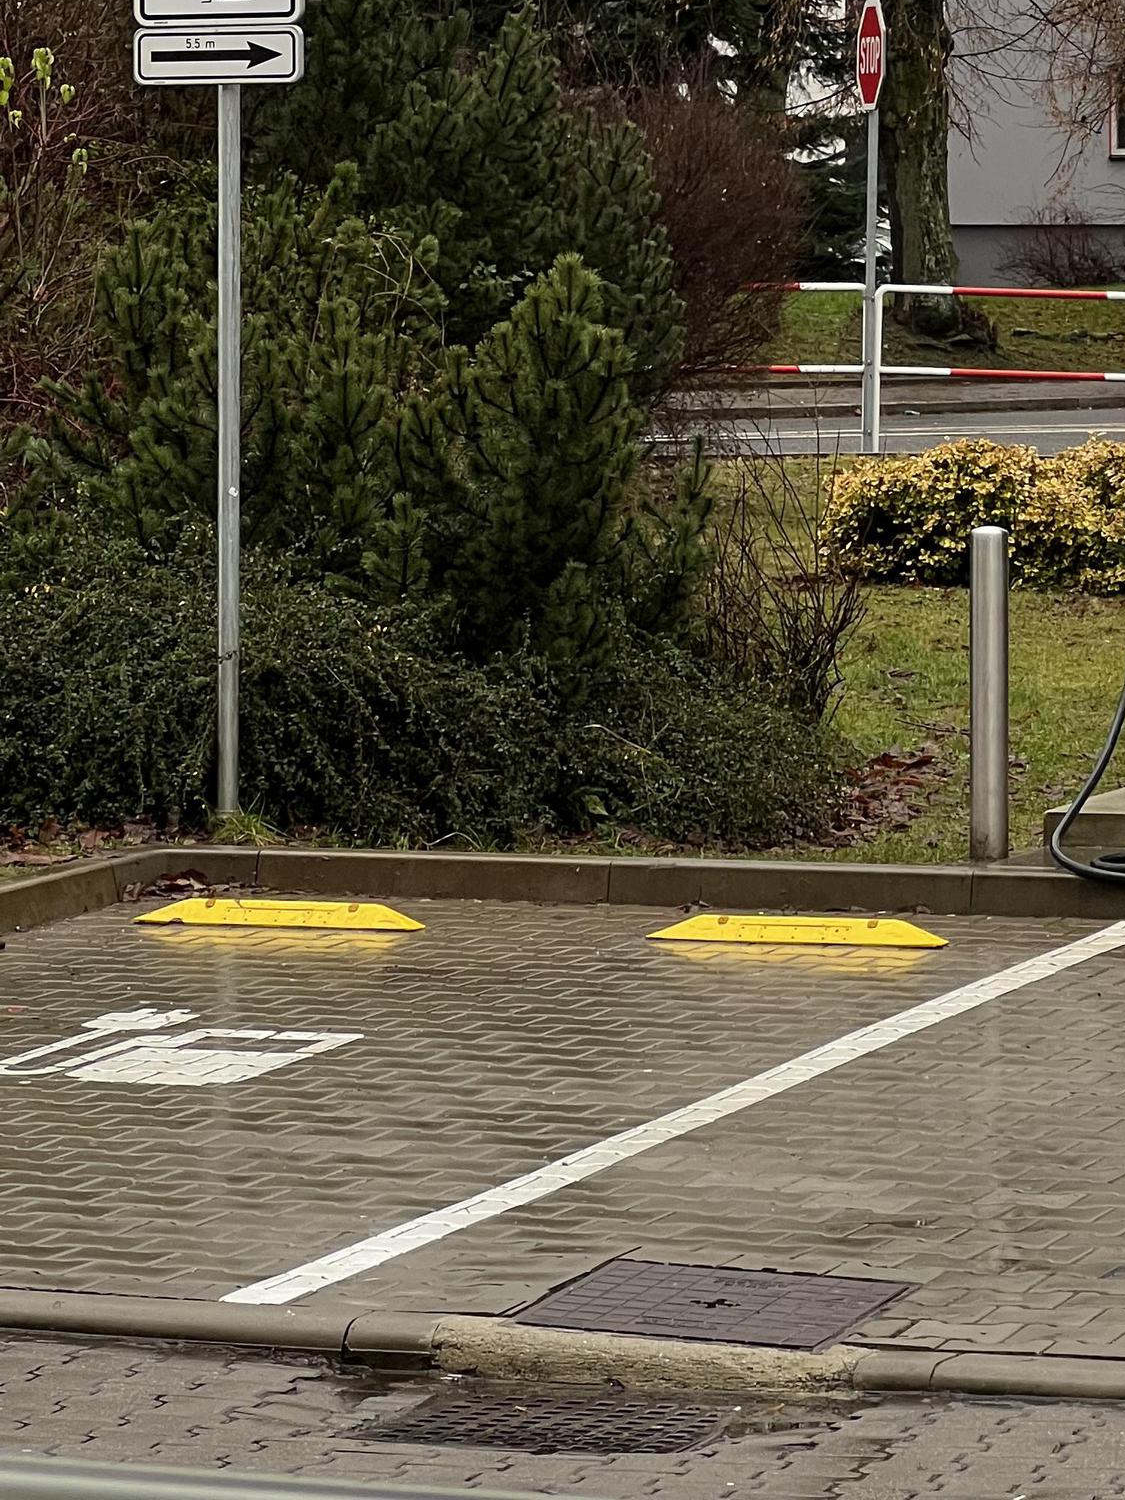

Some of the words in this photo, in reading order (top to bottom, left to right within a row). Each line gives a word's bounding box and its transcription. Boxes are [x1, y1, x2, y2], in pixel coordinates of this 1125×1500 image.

[186, 38, 201, 49] 5.5
[205, 40, 216, 49] m
[860, 36, 881, 74] STOP
